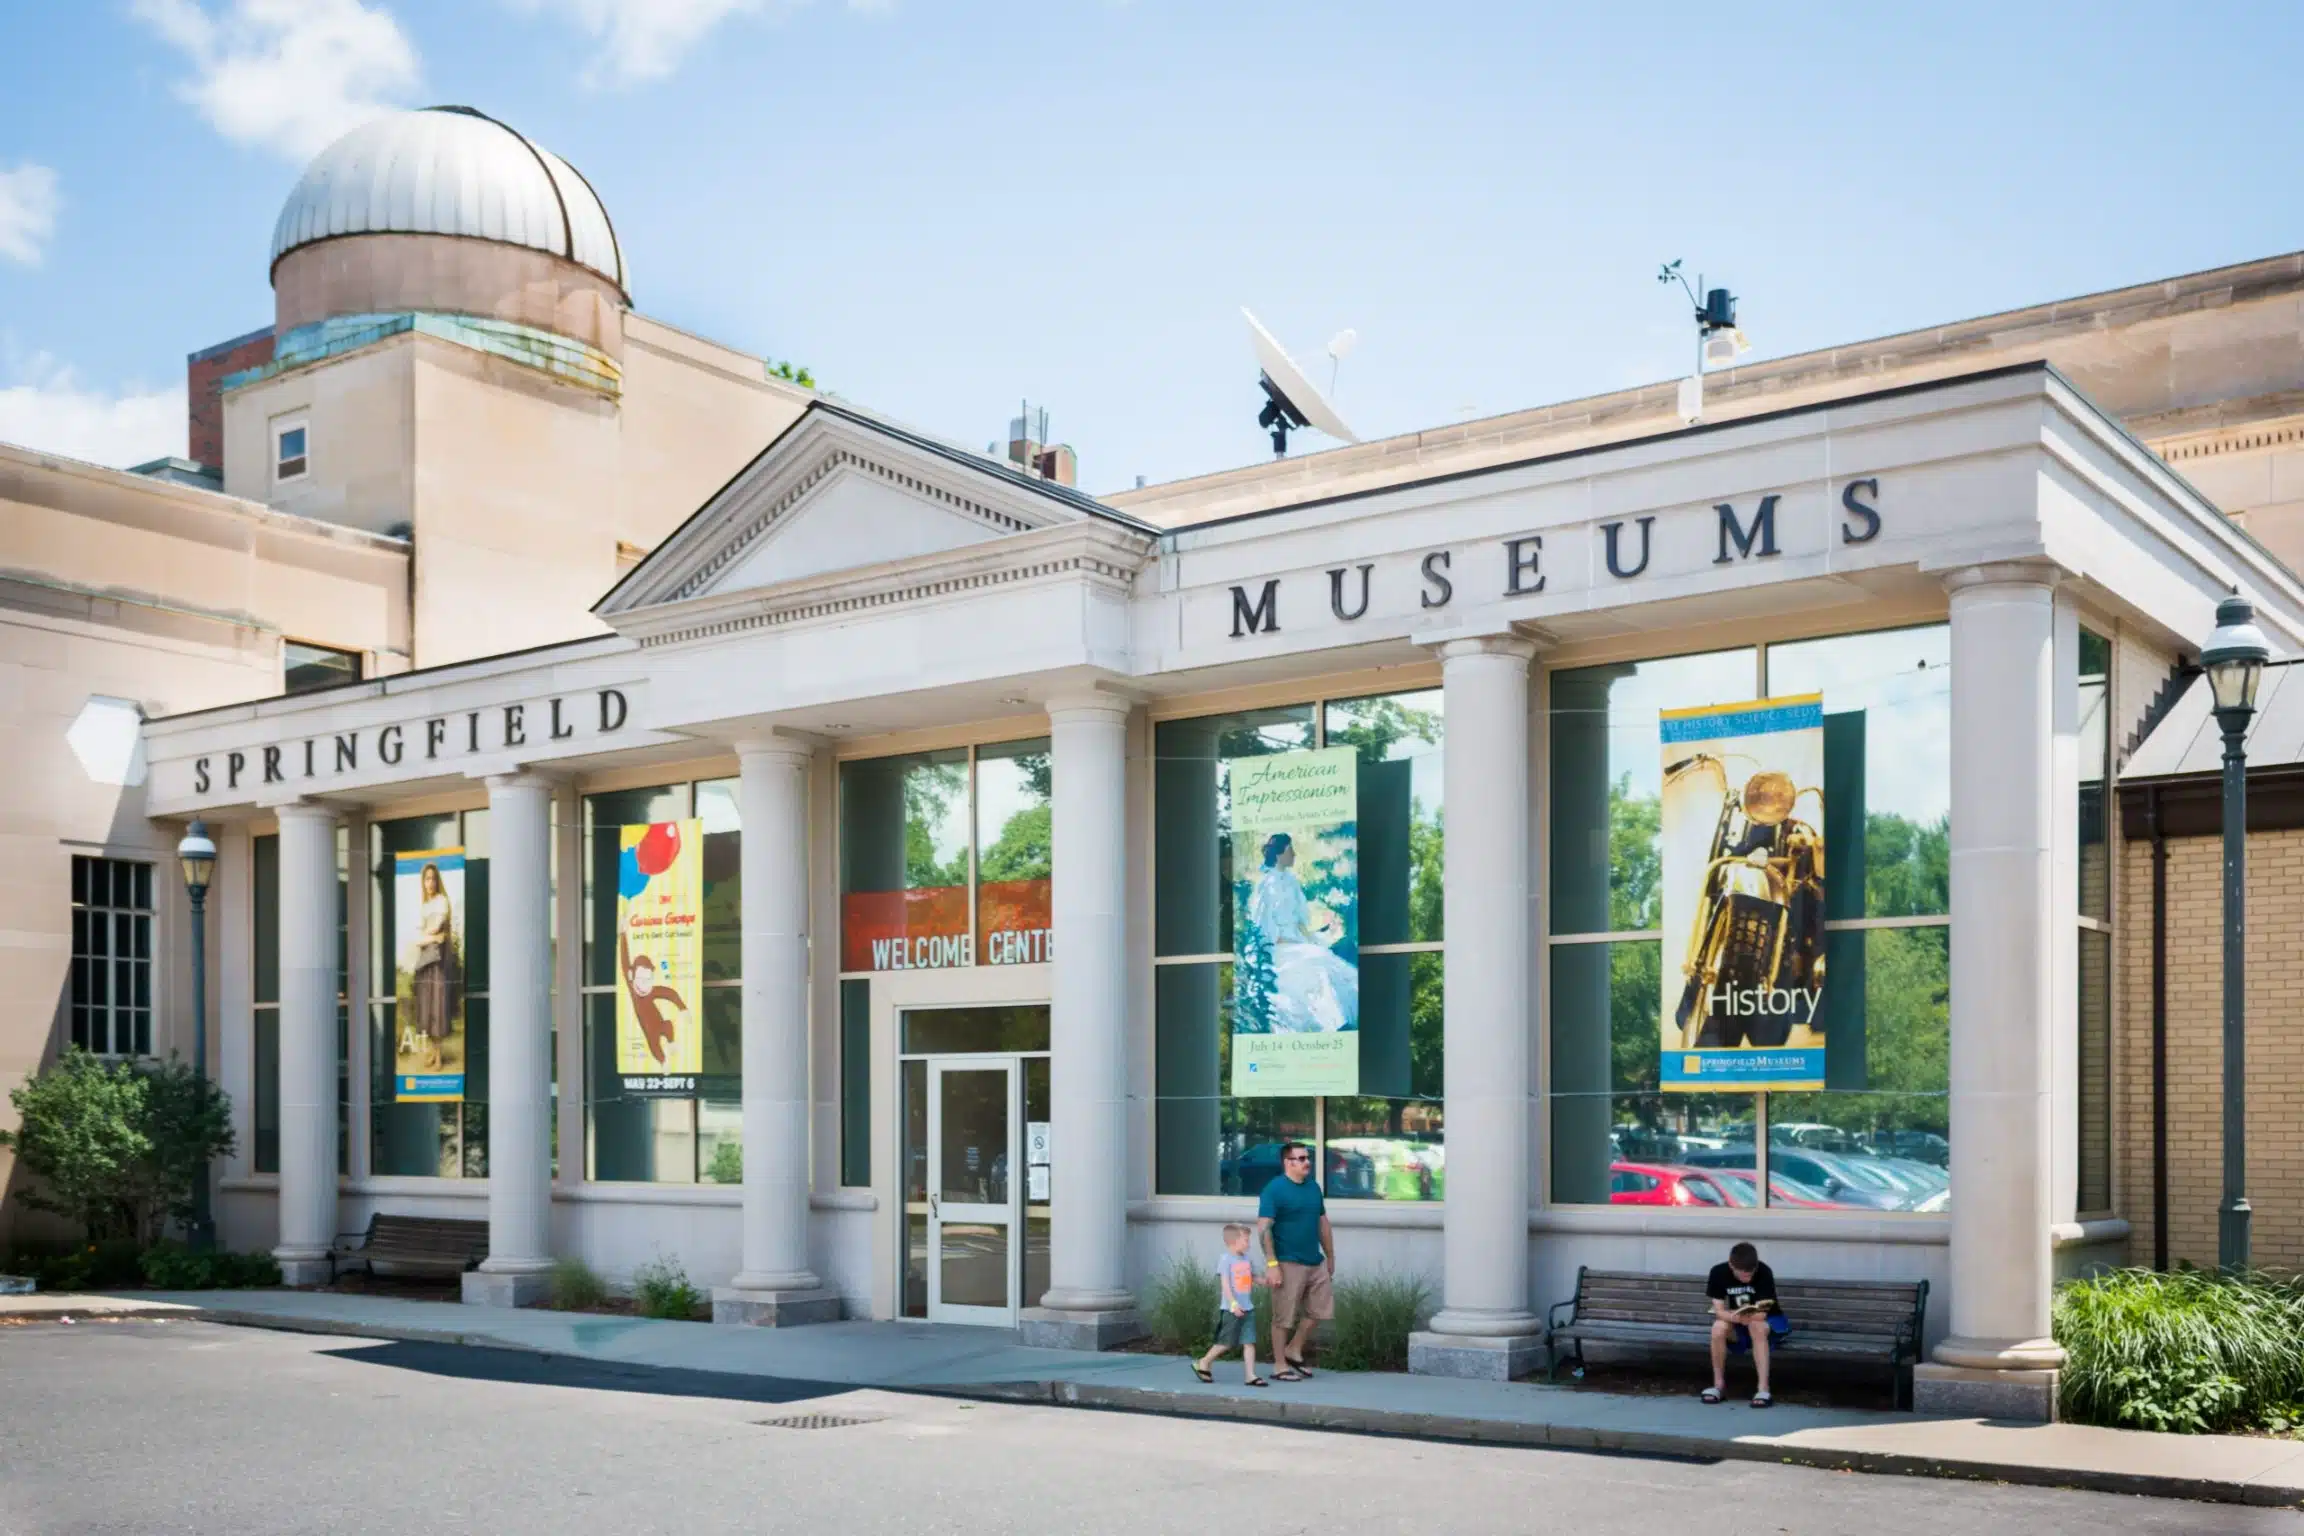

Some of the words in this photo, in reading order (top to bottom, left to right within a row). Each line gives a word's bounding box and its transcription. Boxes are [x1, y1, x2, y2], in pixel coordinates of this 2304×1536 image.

[1227, 478, 1882, 638] MUSEUMS
[194, 689, 628, 794] SPRINGFIELD
[1250, 761, 1338, 786] American
[1237, 784, 1350, 813] Impressionism
[872, 933, 970, 971] WELCOME
[1706, 980, 1823, 1024] History
[400, 1025, 429, 1053] Art
[1249, 1040, 1268, 1053] July
[1271, 1040, 1283, 1051] 14
[1291, 1038, 1330, 1051] October
